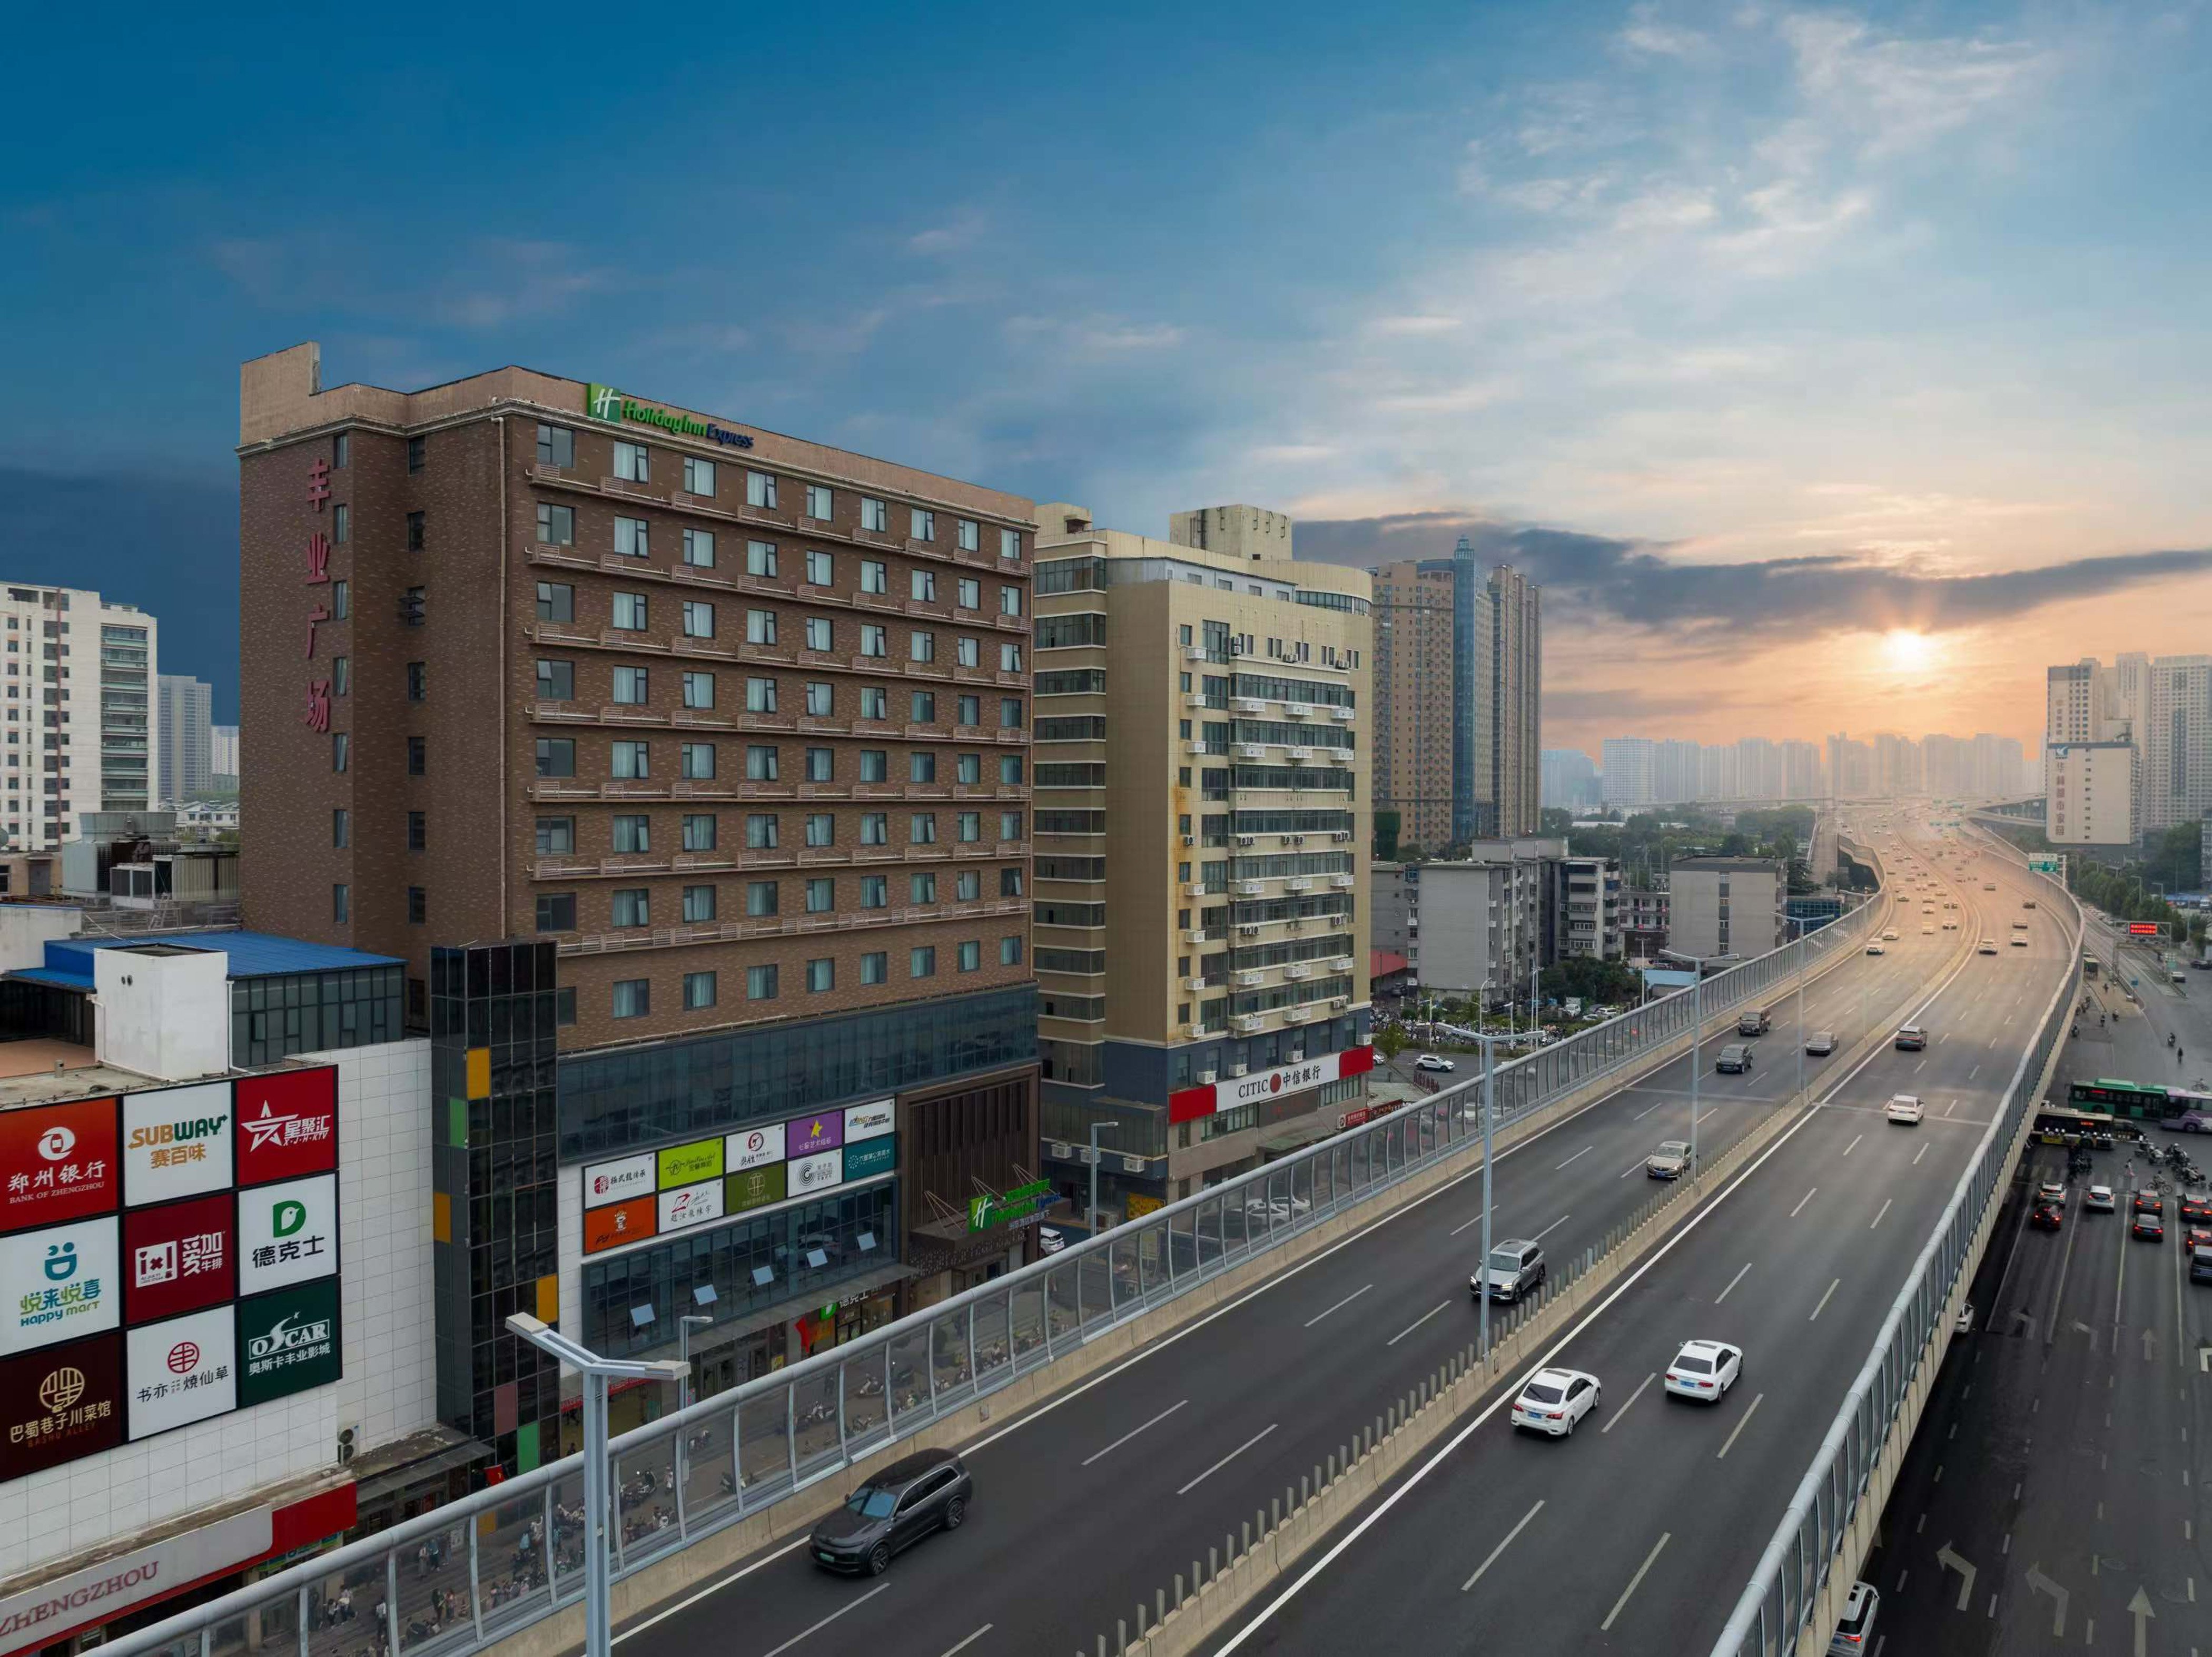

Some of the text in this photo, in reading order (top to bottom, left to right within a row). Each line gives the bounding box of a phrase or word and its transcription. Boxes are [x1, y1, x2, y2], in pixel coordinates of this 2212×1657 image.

[623, 400, 754, 448] Holiday Inn Express
[306, 458, 331, 732] 丰业广场
[1239, 1079, 1268, 1098] CITIC
[1283, 1064, 1321, 1088] 中信银行
[128, 1113, 228, 1149] SUBWAY
[284, 1114, 331, 1139] 星聚汇
[151, 1142, 206, 1169] 赛百味
[7, 1160, 106, 1194] 郑州银行
[9, 1181, 105, 1204] BANK OF ZHENGZHOU
[201, 1258, 223, 1271] 牛排
[252, 1235, 325, 1268] 德克士
[20, 1278, 102, 1316] 悦来悦喜
[21, 1309, 63, 1327] Happy
[252, 1317, 328, 1356] OSCAR
[249, 1342, 331, 1376] 奥斯卡丰业影城
[10, 1400, 112, 1443] 巴蜀巷子川菜馆
[0, 1561, 159, 1637] ZHENGZHOU
